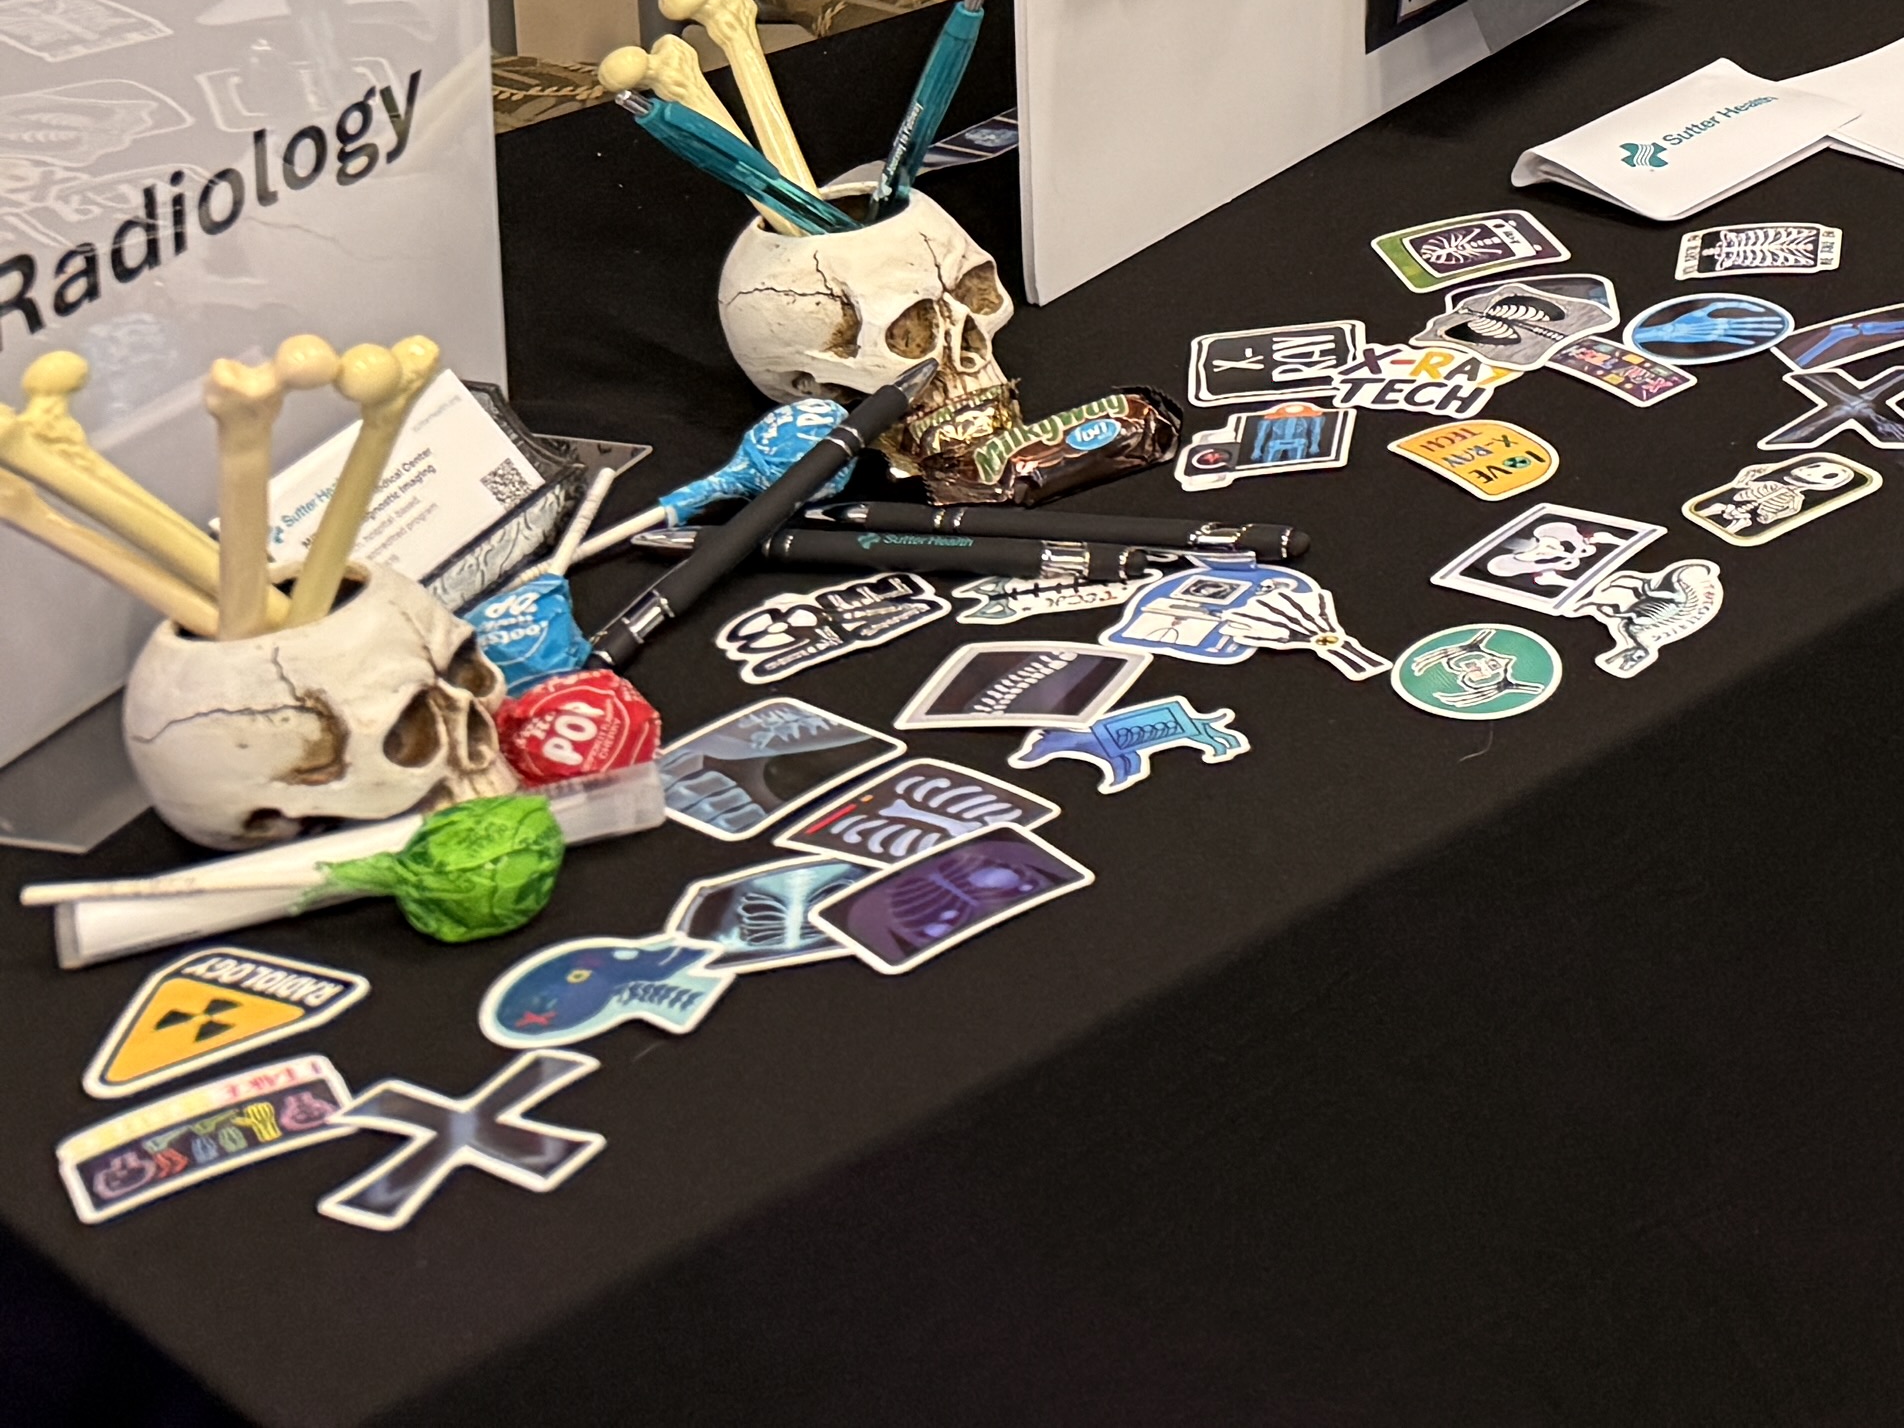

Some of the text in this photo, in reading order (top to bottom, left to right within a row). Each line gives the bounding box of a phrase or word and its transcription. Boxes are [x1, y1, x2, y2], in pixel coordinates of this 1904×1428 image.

[1662, 115, 1721, 146] Sutter
[0, 67, 424, 339] Radiology
[1340, 377, 1487, 414] TECH
[181, 957, 344, 1007] RADIOLOGY
